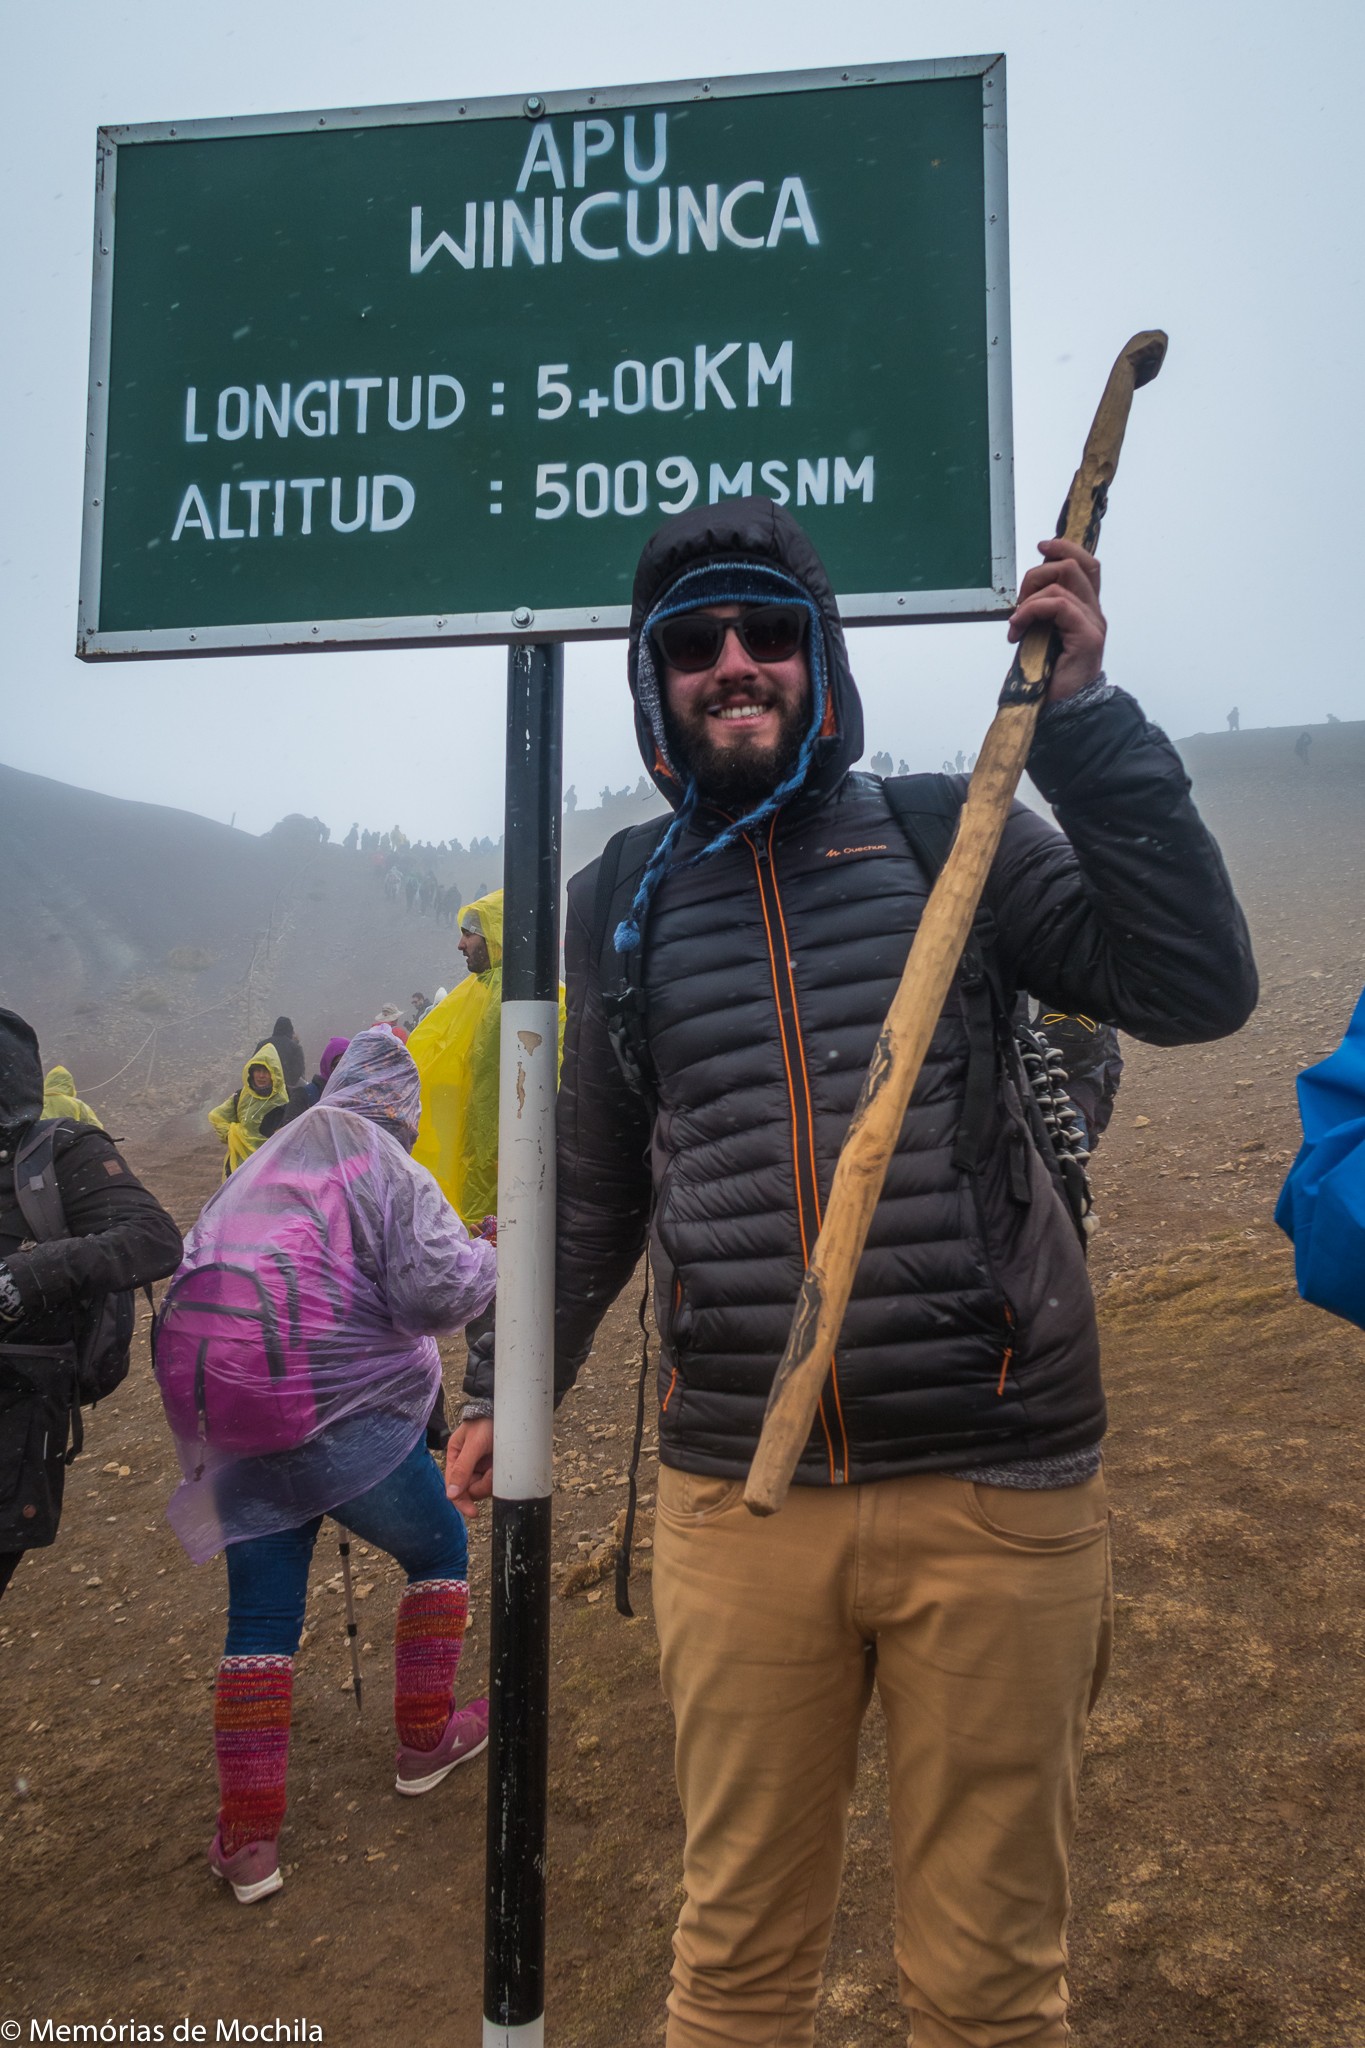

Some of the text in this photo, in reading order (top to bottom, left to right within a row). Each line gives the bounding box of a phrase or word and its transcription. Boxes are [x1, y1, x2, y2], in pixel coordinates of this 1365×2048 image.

[515, 112, 668, 193] APU
[410, 176, 820, 274] WINICUNCA
[184, 374, 466, 444] LONGITUD
[170, 474, 416, 542] ALTITUD
[843, 844, 887, 854] Quechua
